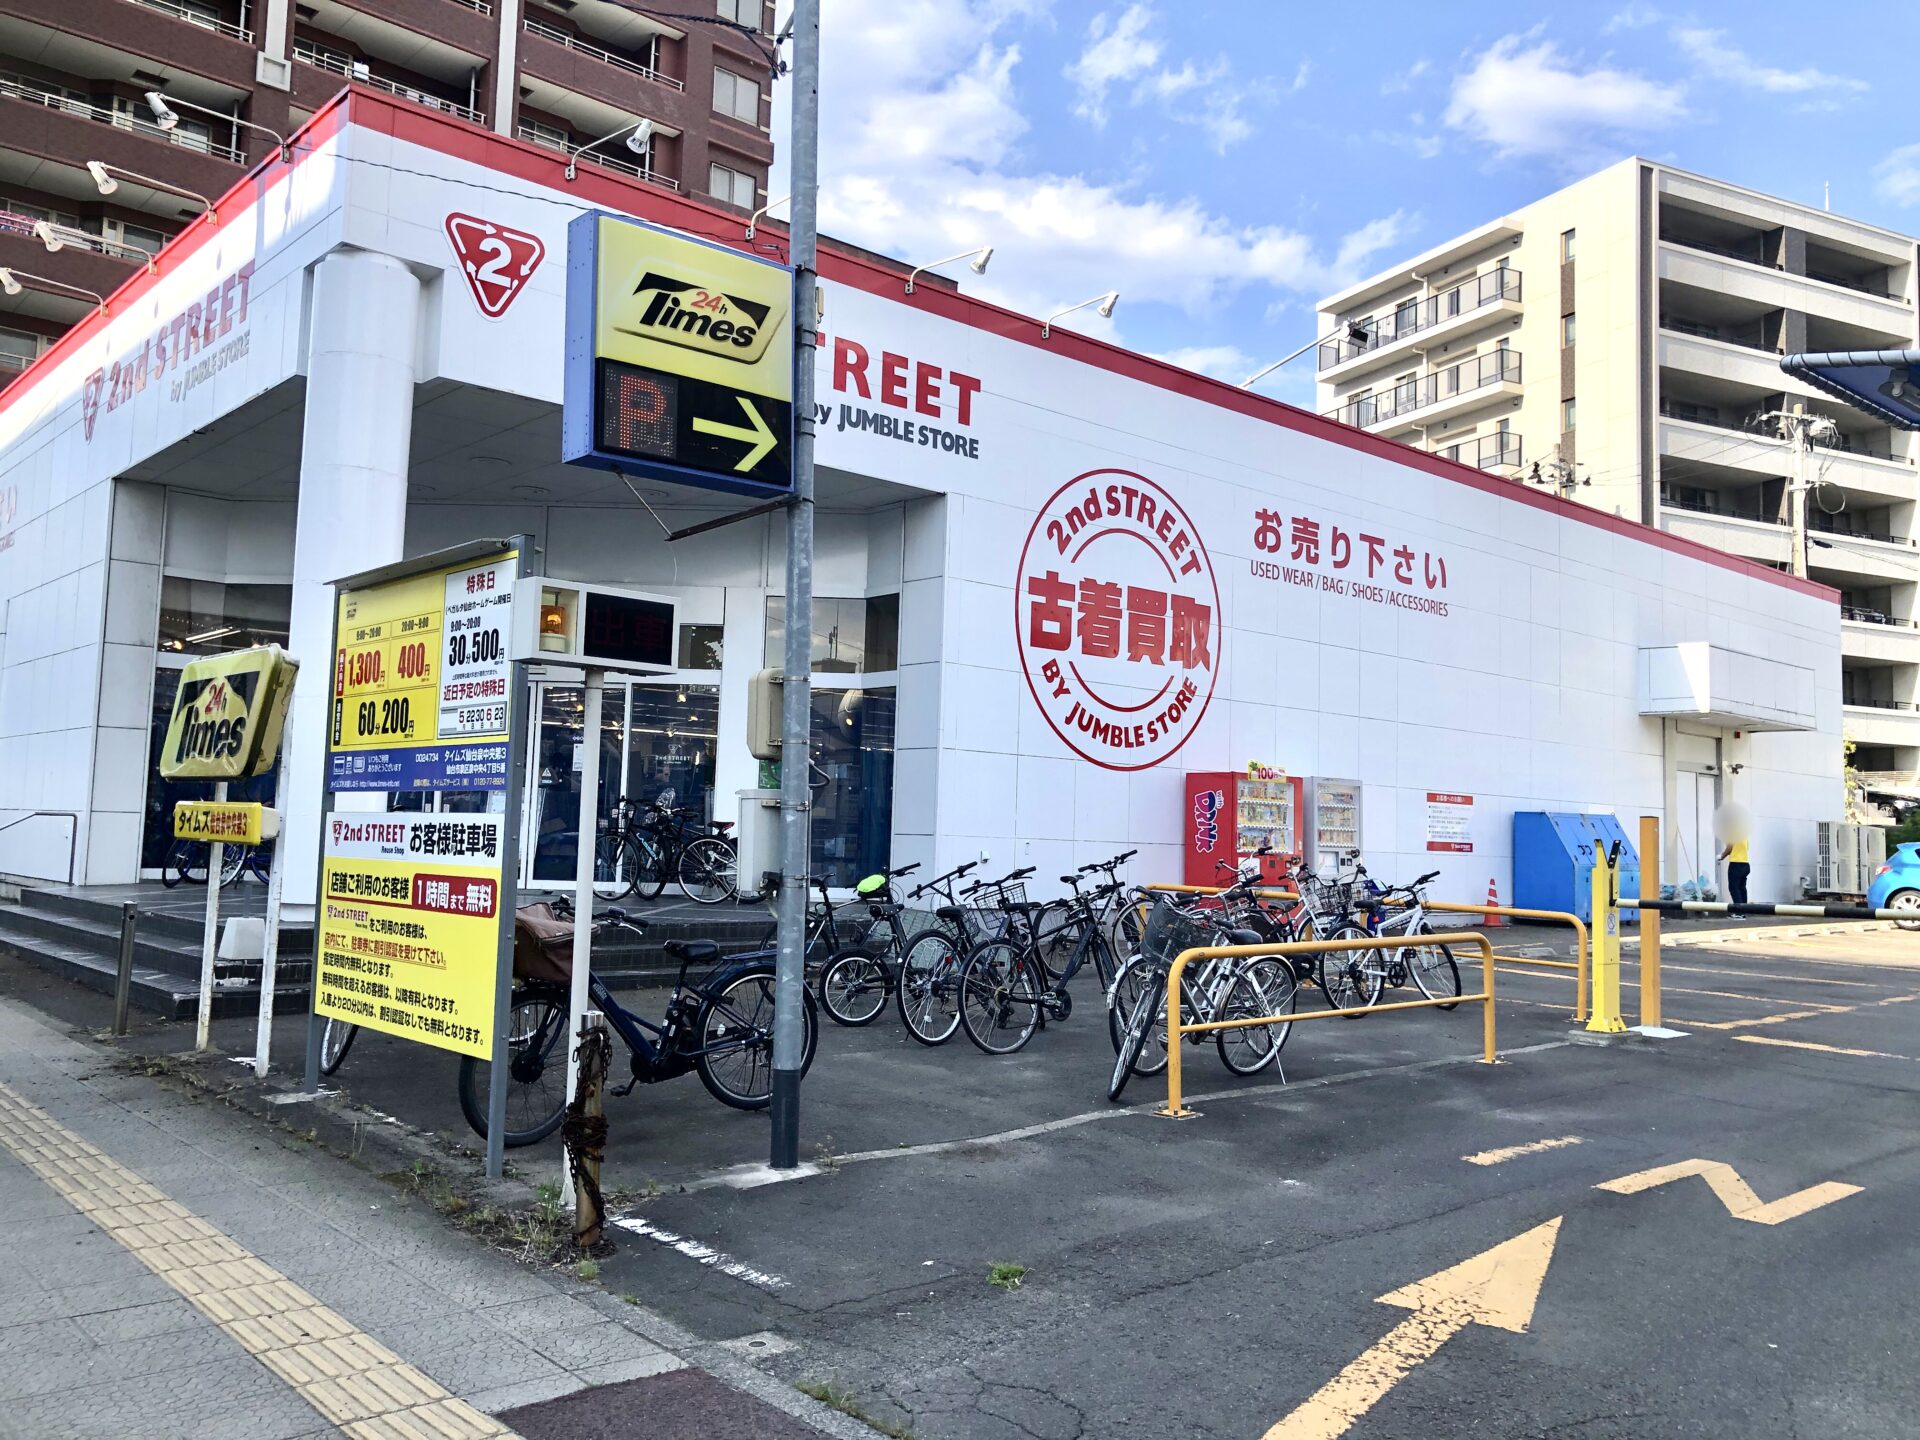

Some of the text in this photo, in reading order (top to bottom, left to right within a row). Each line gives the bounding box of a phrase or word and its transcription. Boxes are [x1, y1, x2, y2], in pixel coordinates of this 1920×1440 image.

[107, 258, 256, 414] 2nd STREET
[638, 291, 758, 348] Times
[182, 351, 217, 402] JUMBLE
[217, 329, 251, 372] STORE
[619, 375, 667, 450] P
[837, 403, 915, 443] JUMBLE
[917, 425, 979, 460] STORE
[1046, 484, 1203, 575] 2nd STREET
[1253, 508, 1448, 589] お売り下さい
[466, 570, 495, 594] 特殊日
[1250, 559, 1281, 581] USED
[1282, 566, 1314, 589] WEAR
[1322, 576, 1344, 596] BAG
[1352, 582, 1384, 604] SHOES
[1389, 592, 1449, 617] ACCESSORIES
[1028, 570, 1212, 672] 古着買取
[443, 678, 505, 701] 近日予定の特殊日
[1041, 658, 1071, 699] BY
[176, 706, 247, 764] Times
[1065, 676, 1199, 749] JUMBLE STORE
[415, 747, 507, 763] 0024734 タイムズ仙台泉中央第3
[343, 824, 406, 843] 2nd STREET
[409, 823, 498, 858] お客様駐車場
[1194, 790, 1218, 853] DRINK
[394, 846, 405, 856] Shop
[330, 871, 410, 901] 店舗ご利用のお客様
[333, 907, 369, 922] 2nd STREET
[369, 918, 428, 940] をご利用のお客様は、
[323, 952, 394, 979] 指定時間内無料となります。
[322, 972, 459, 1016] 無料時間を超えるお客様は、以降有料となります。
